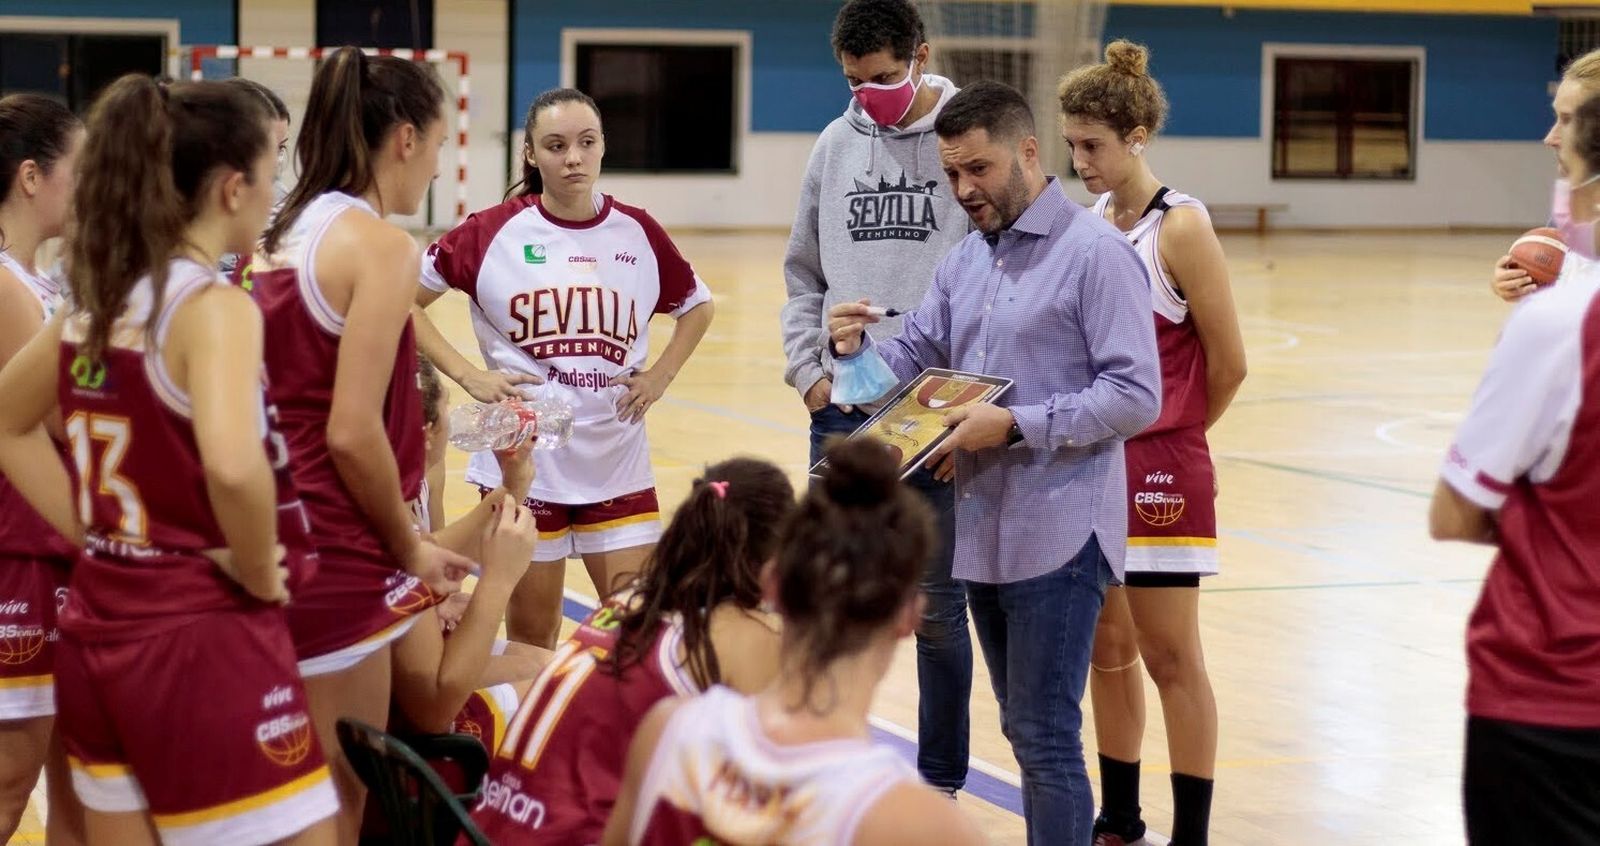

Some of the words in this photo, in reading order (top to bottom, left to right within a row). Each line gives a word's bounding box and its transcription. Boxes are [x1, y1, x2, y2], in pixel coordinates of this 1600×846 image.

[845, 194, 940, 231] SEVILLA
[858, 230, 920, 239] FEMENINO
[509, 286, 638, 345] SEVILLA
[533, 342, 622, 362] FEMENINO
[66, 411, 150, 546] 13
[498, 639, 607, 771] 11
